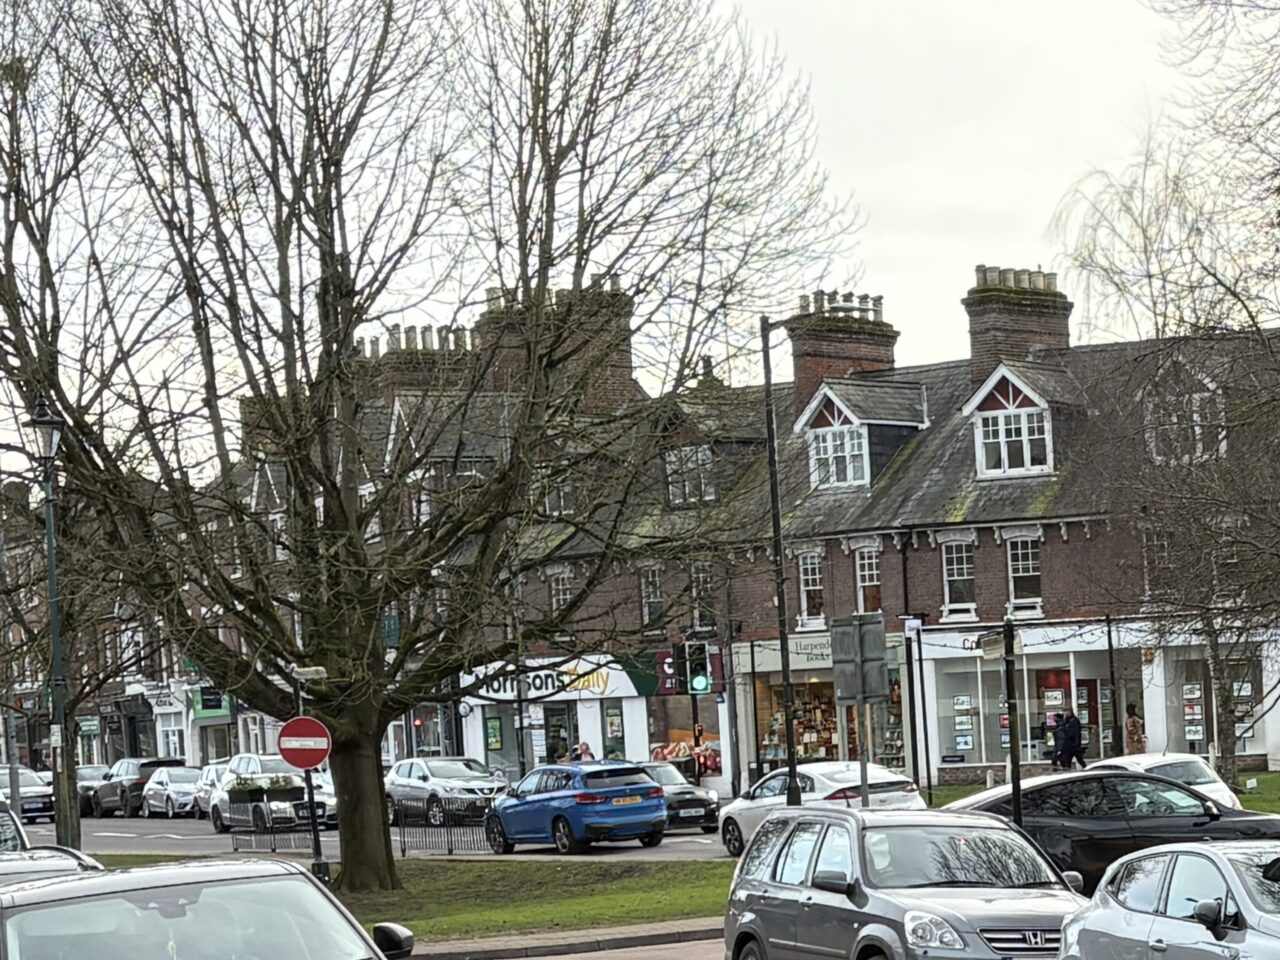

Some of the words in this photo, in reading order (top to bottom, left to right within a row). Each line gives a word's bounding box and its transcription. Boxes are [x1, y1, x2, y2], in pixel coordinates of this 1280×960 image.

[795, 639, 831, 655] Harpend
[474, 671, 565, 694] orrsons
[566, 667, 610, 695] Daily
